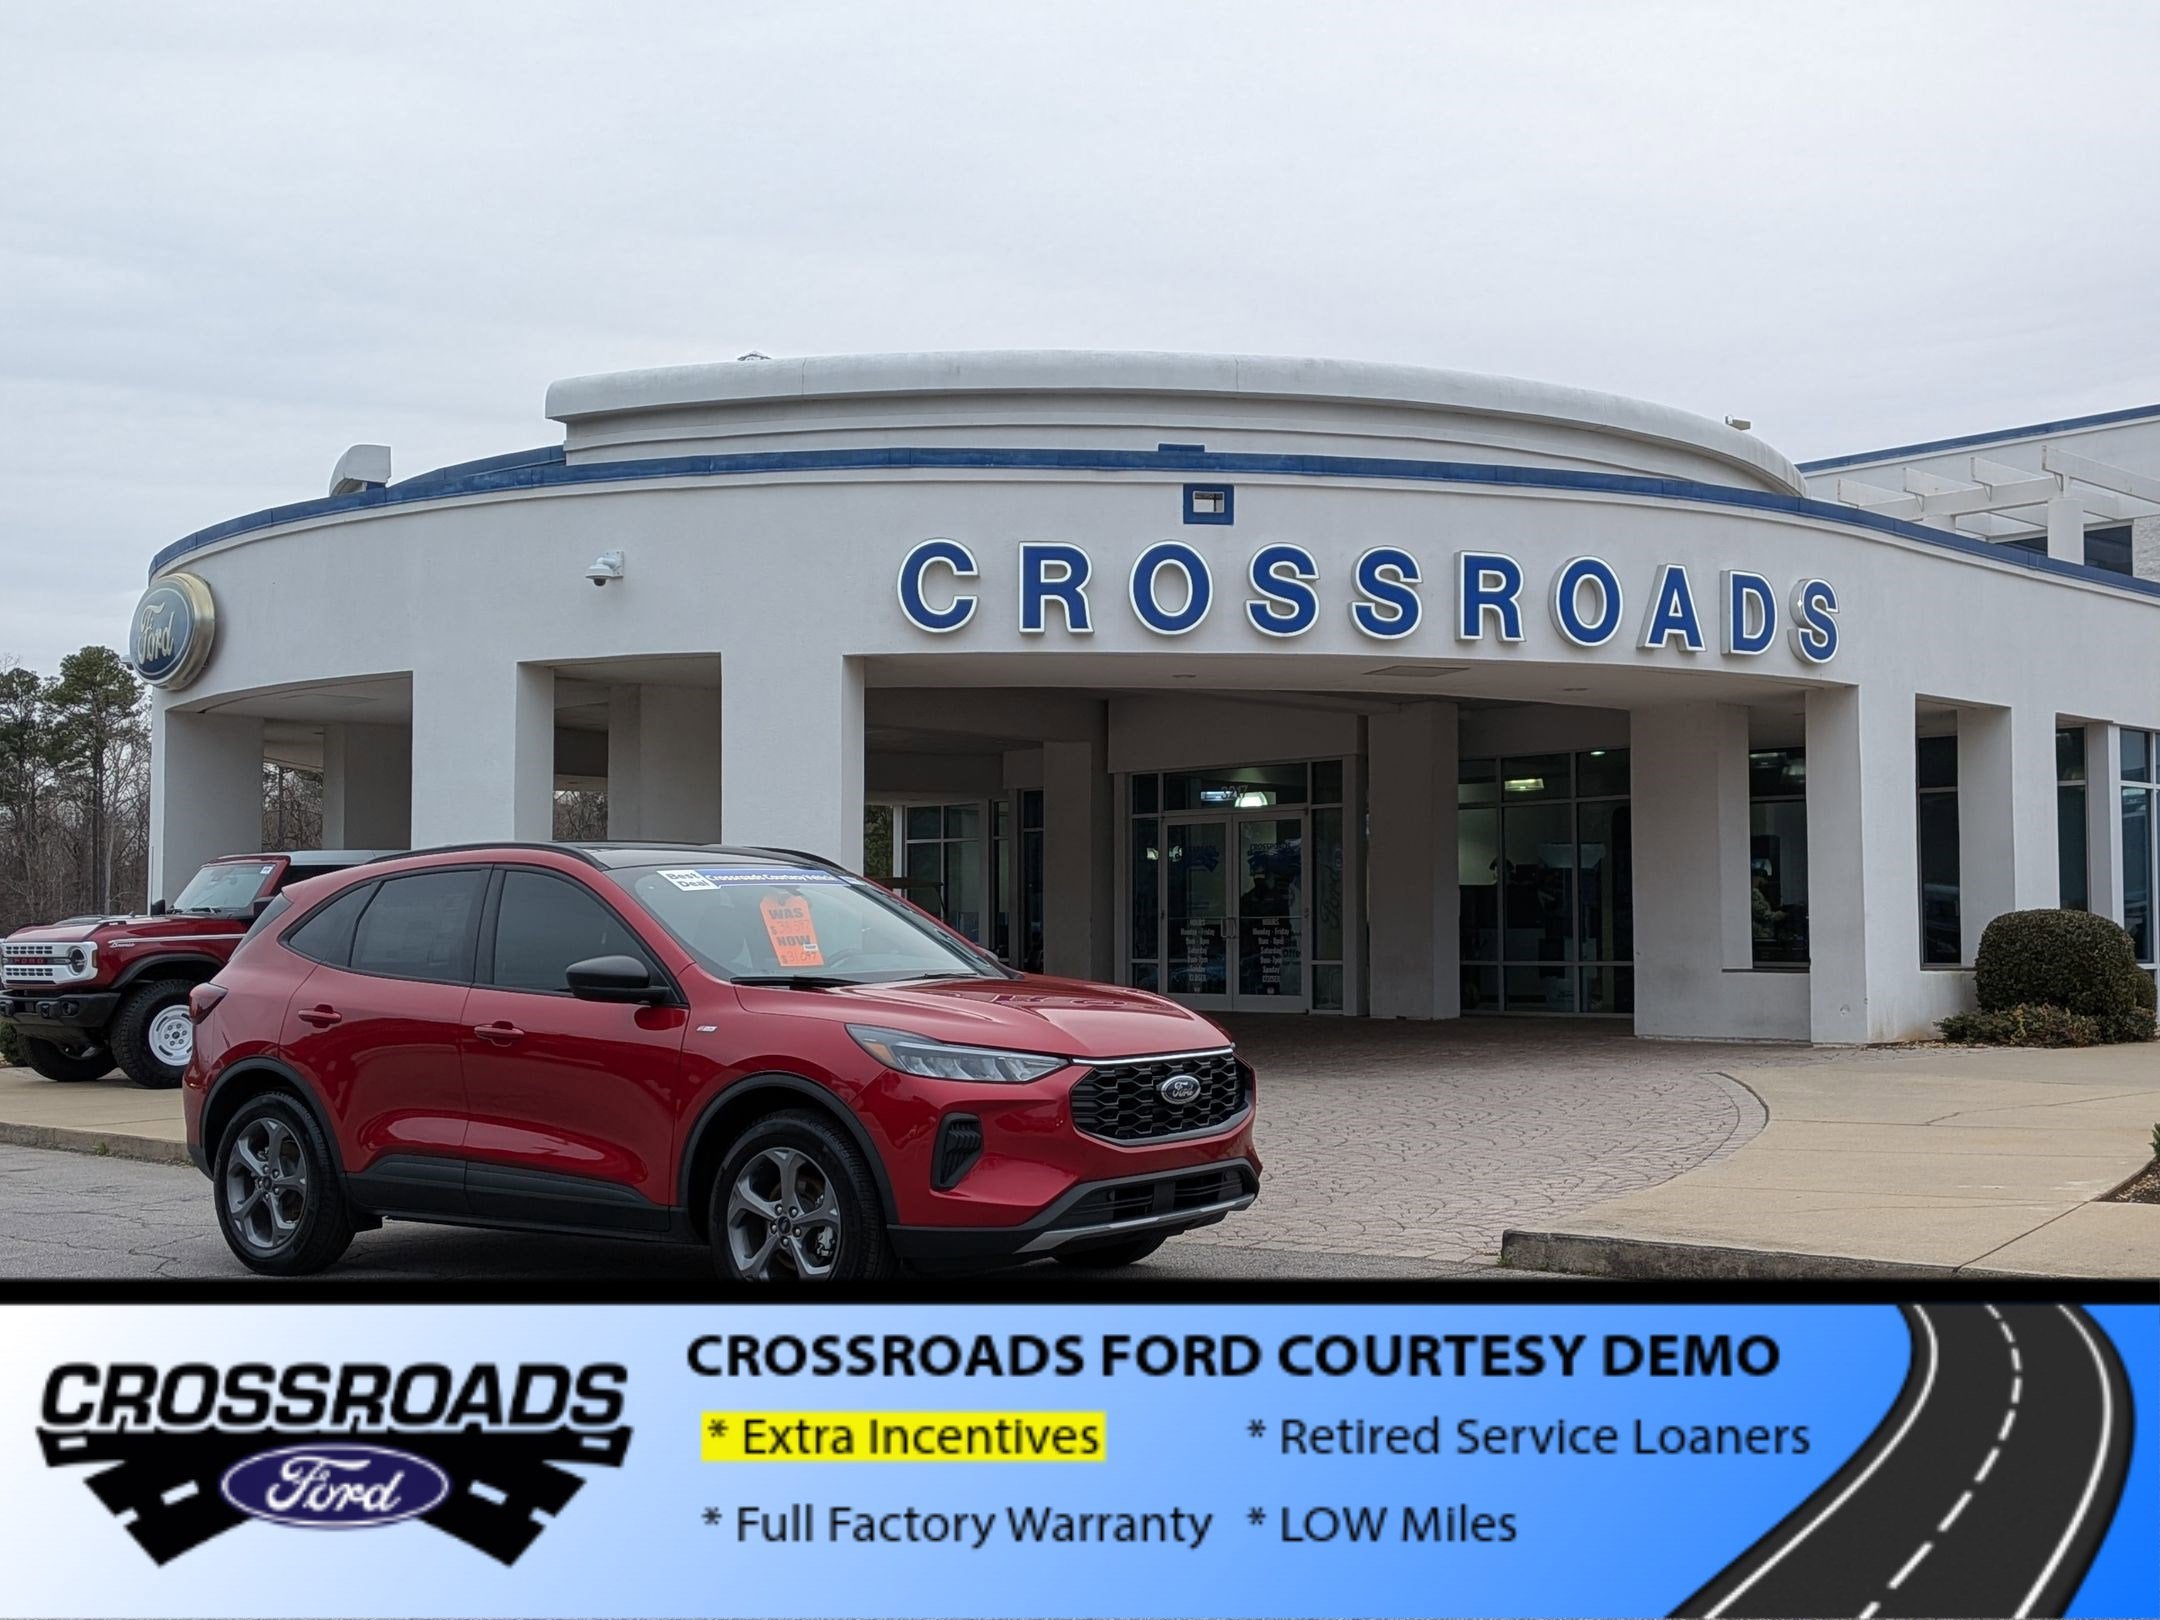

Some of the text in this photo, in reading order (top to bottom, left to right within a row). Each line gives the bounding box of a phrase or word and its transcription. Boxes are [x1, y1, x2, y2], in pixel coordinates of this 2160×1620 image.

[897, 538, 1839, 664] CROSSROADS
[138, 602, 175, 665] Ford
[667, 872, 699, 880] Best
[677, 880, 710, 888] Deal
[769, 908, 804, 919] WAS
[777, 936, 811, 946] NOW
[1172, 1081, 1194, 1098] Ford
